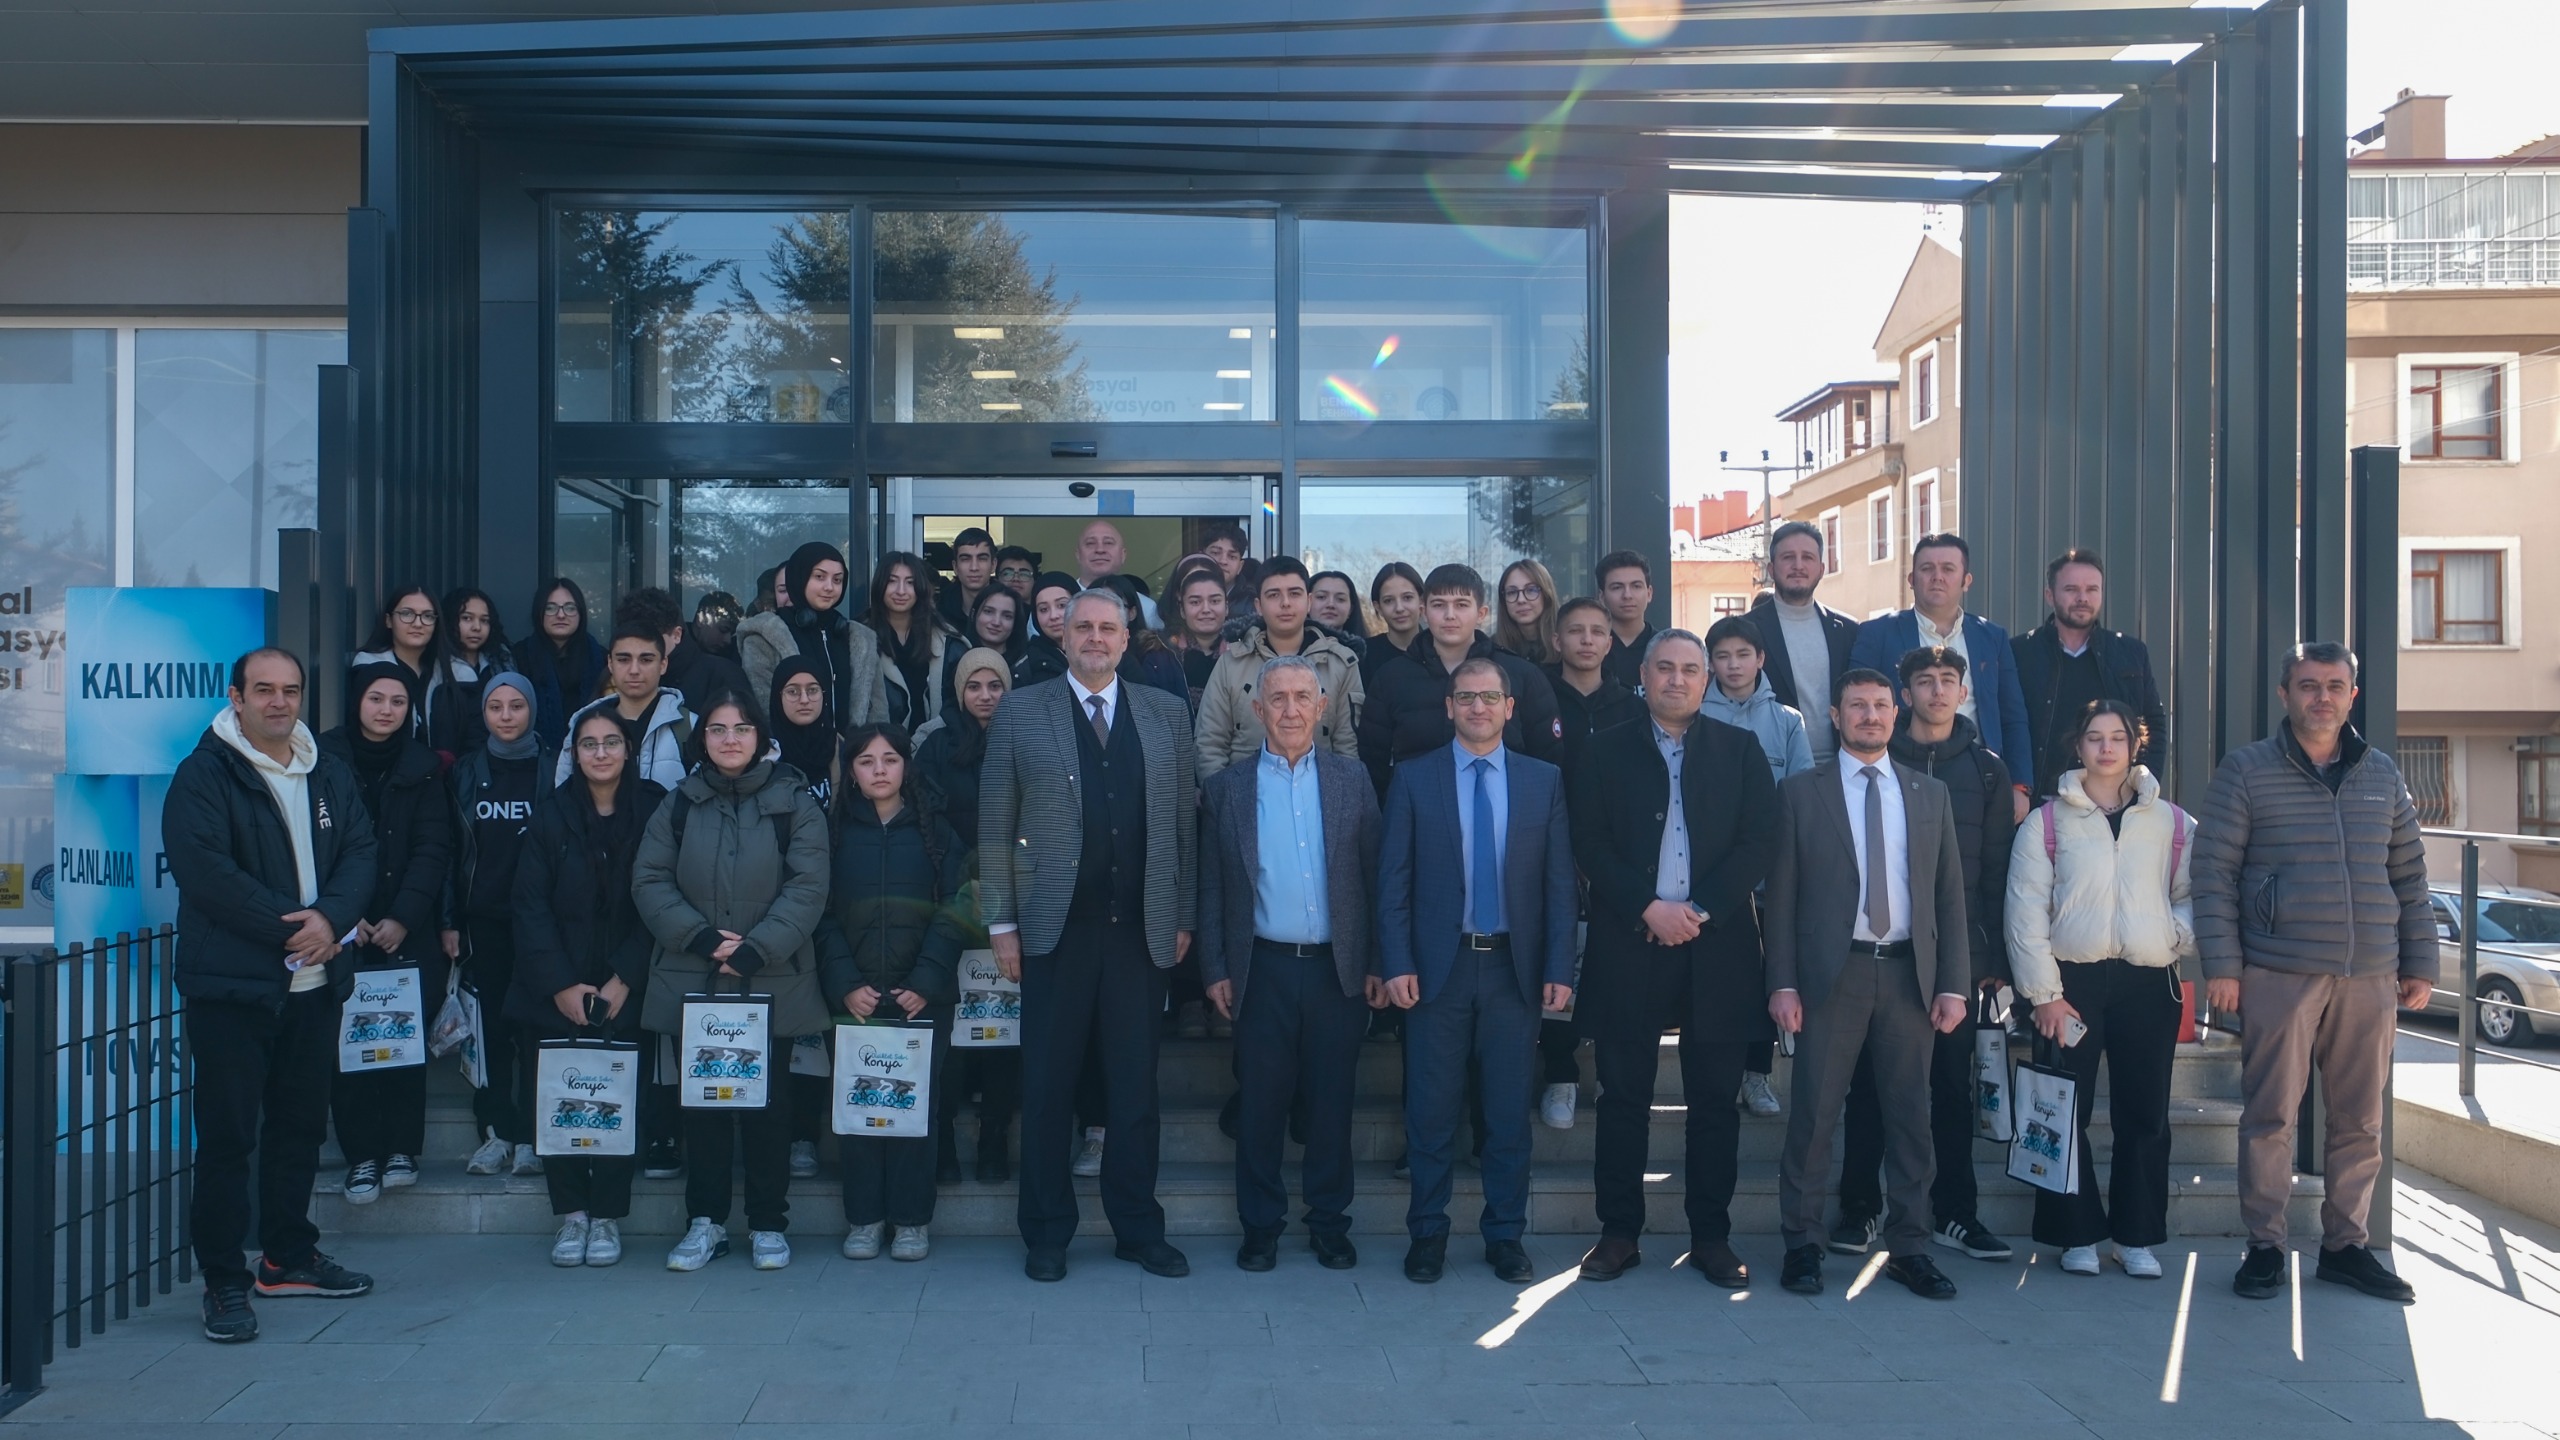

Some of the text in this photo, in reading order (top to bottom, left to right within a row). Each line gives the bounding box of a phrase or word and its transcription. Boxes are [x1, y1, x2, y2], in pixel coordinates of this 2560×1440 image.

[319, 797, 332, 830] IKE
[60, 846, 135, 889] PLANLAMA
[360, 989, 398, 1007] Konya
[706, 1022, 746, 1042] Konya
[864, 1052, 903, 1074] Konya
[567, 1075, 608, 1096] Konya
